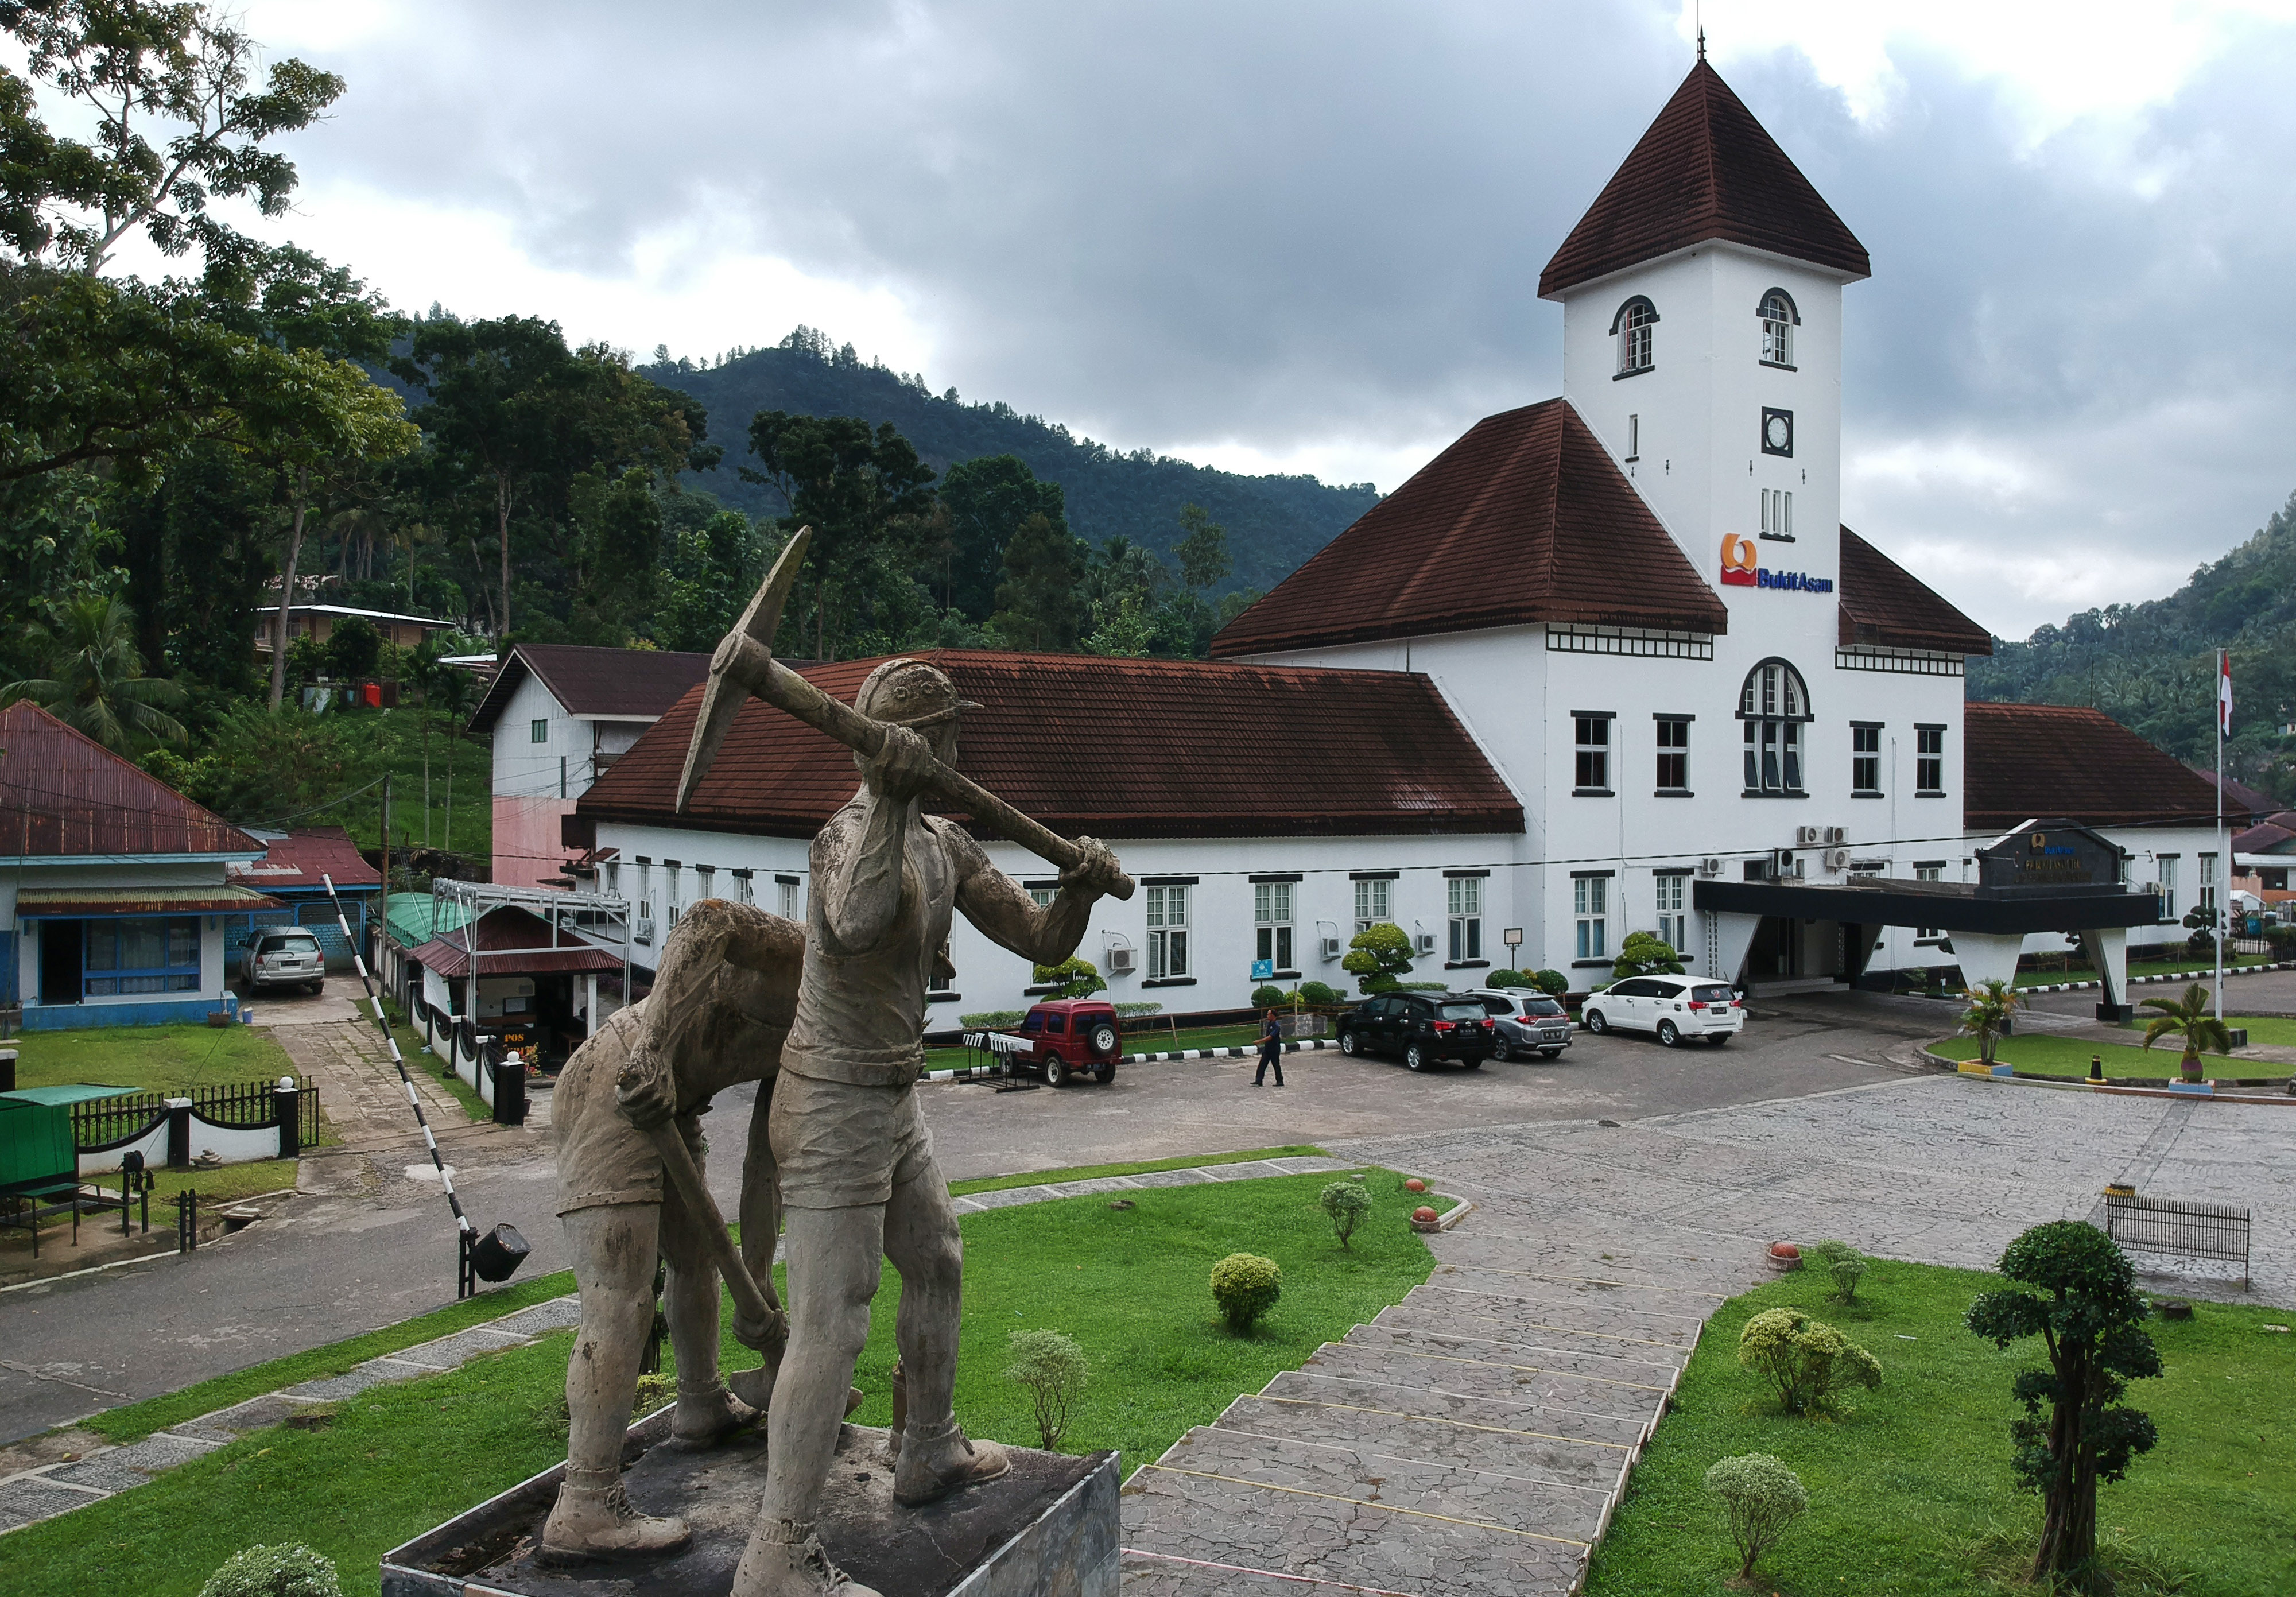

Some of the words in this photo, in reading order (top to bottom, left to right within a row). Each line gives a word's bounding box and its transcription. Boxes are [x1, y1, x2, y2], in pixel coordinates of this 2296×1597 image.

[1758, 568, 1798, 590] Bukit
[1798, 572, 1833, 592] Asam
[505, 1033, 524, 1042] POS
